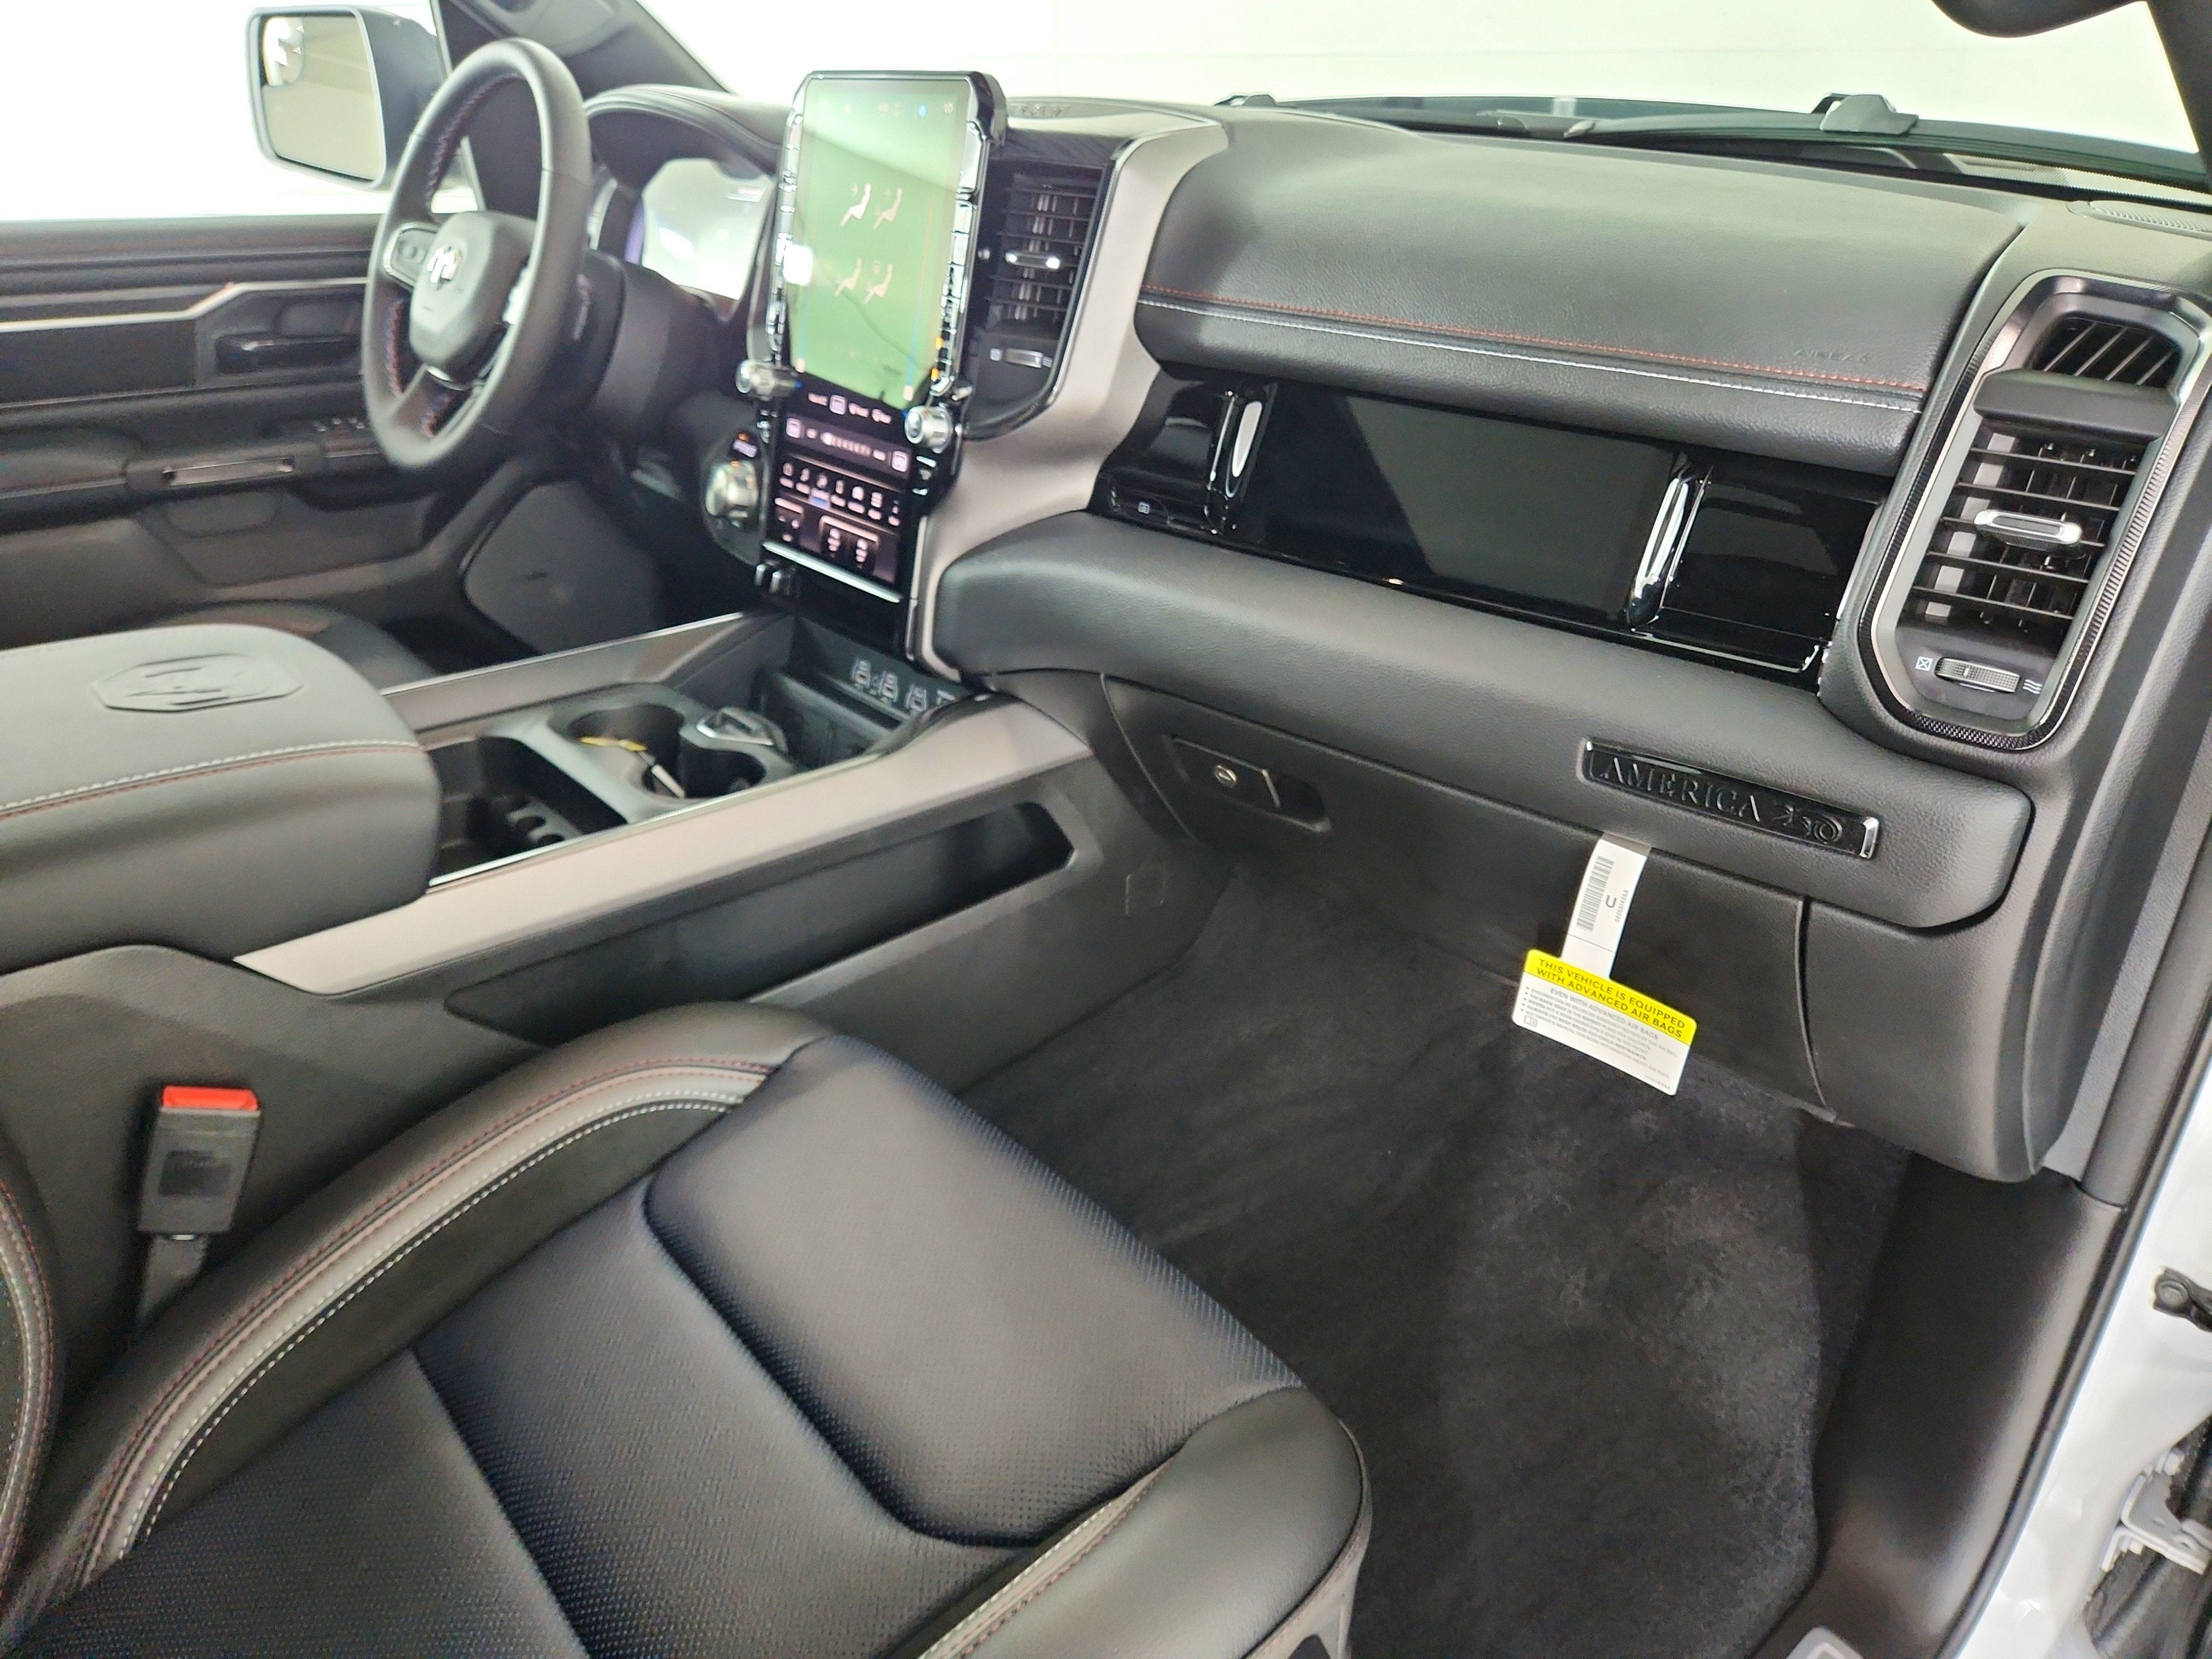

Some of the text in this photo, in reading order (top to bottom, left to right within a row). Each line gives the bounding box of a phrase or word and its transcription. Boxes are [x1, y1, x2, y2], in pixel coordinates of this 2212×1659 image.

[1601, 757, 1760, 822] AMERICA
[1606, 895, 1616, 908] U
[1537, 968, 1683, 1038] WITH ADVANCED AIR BAGS
[1539, 959, 1685, 1029] THIS VEHICLE IS EQUIPPED
